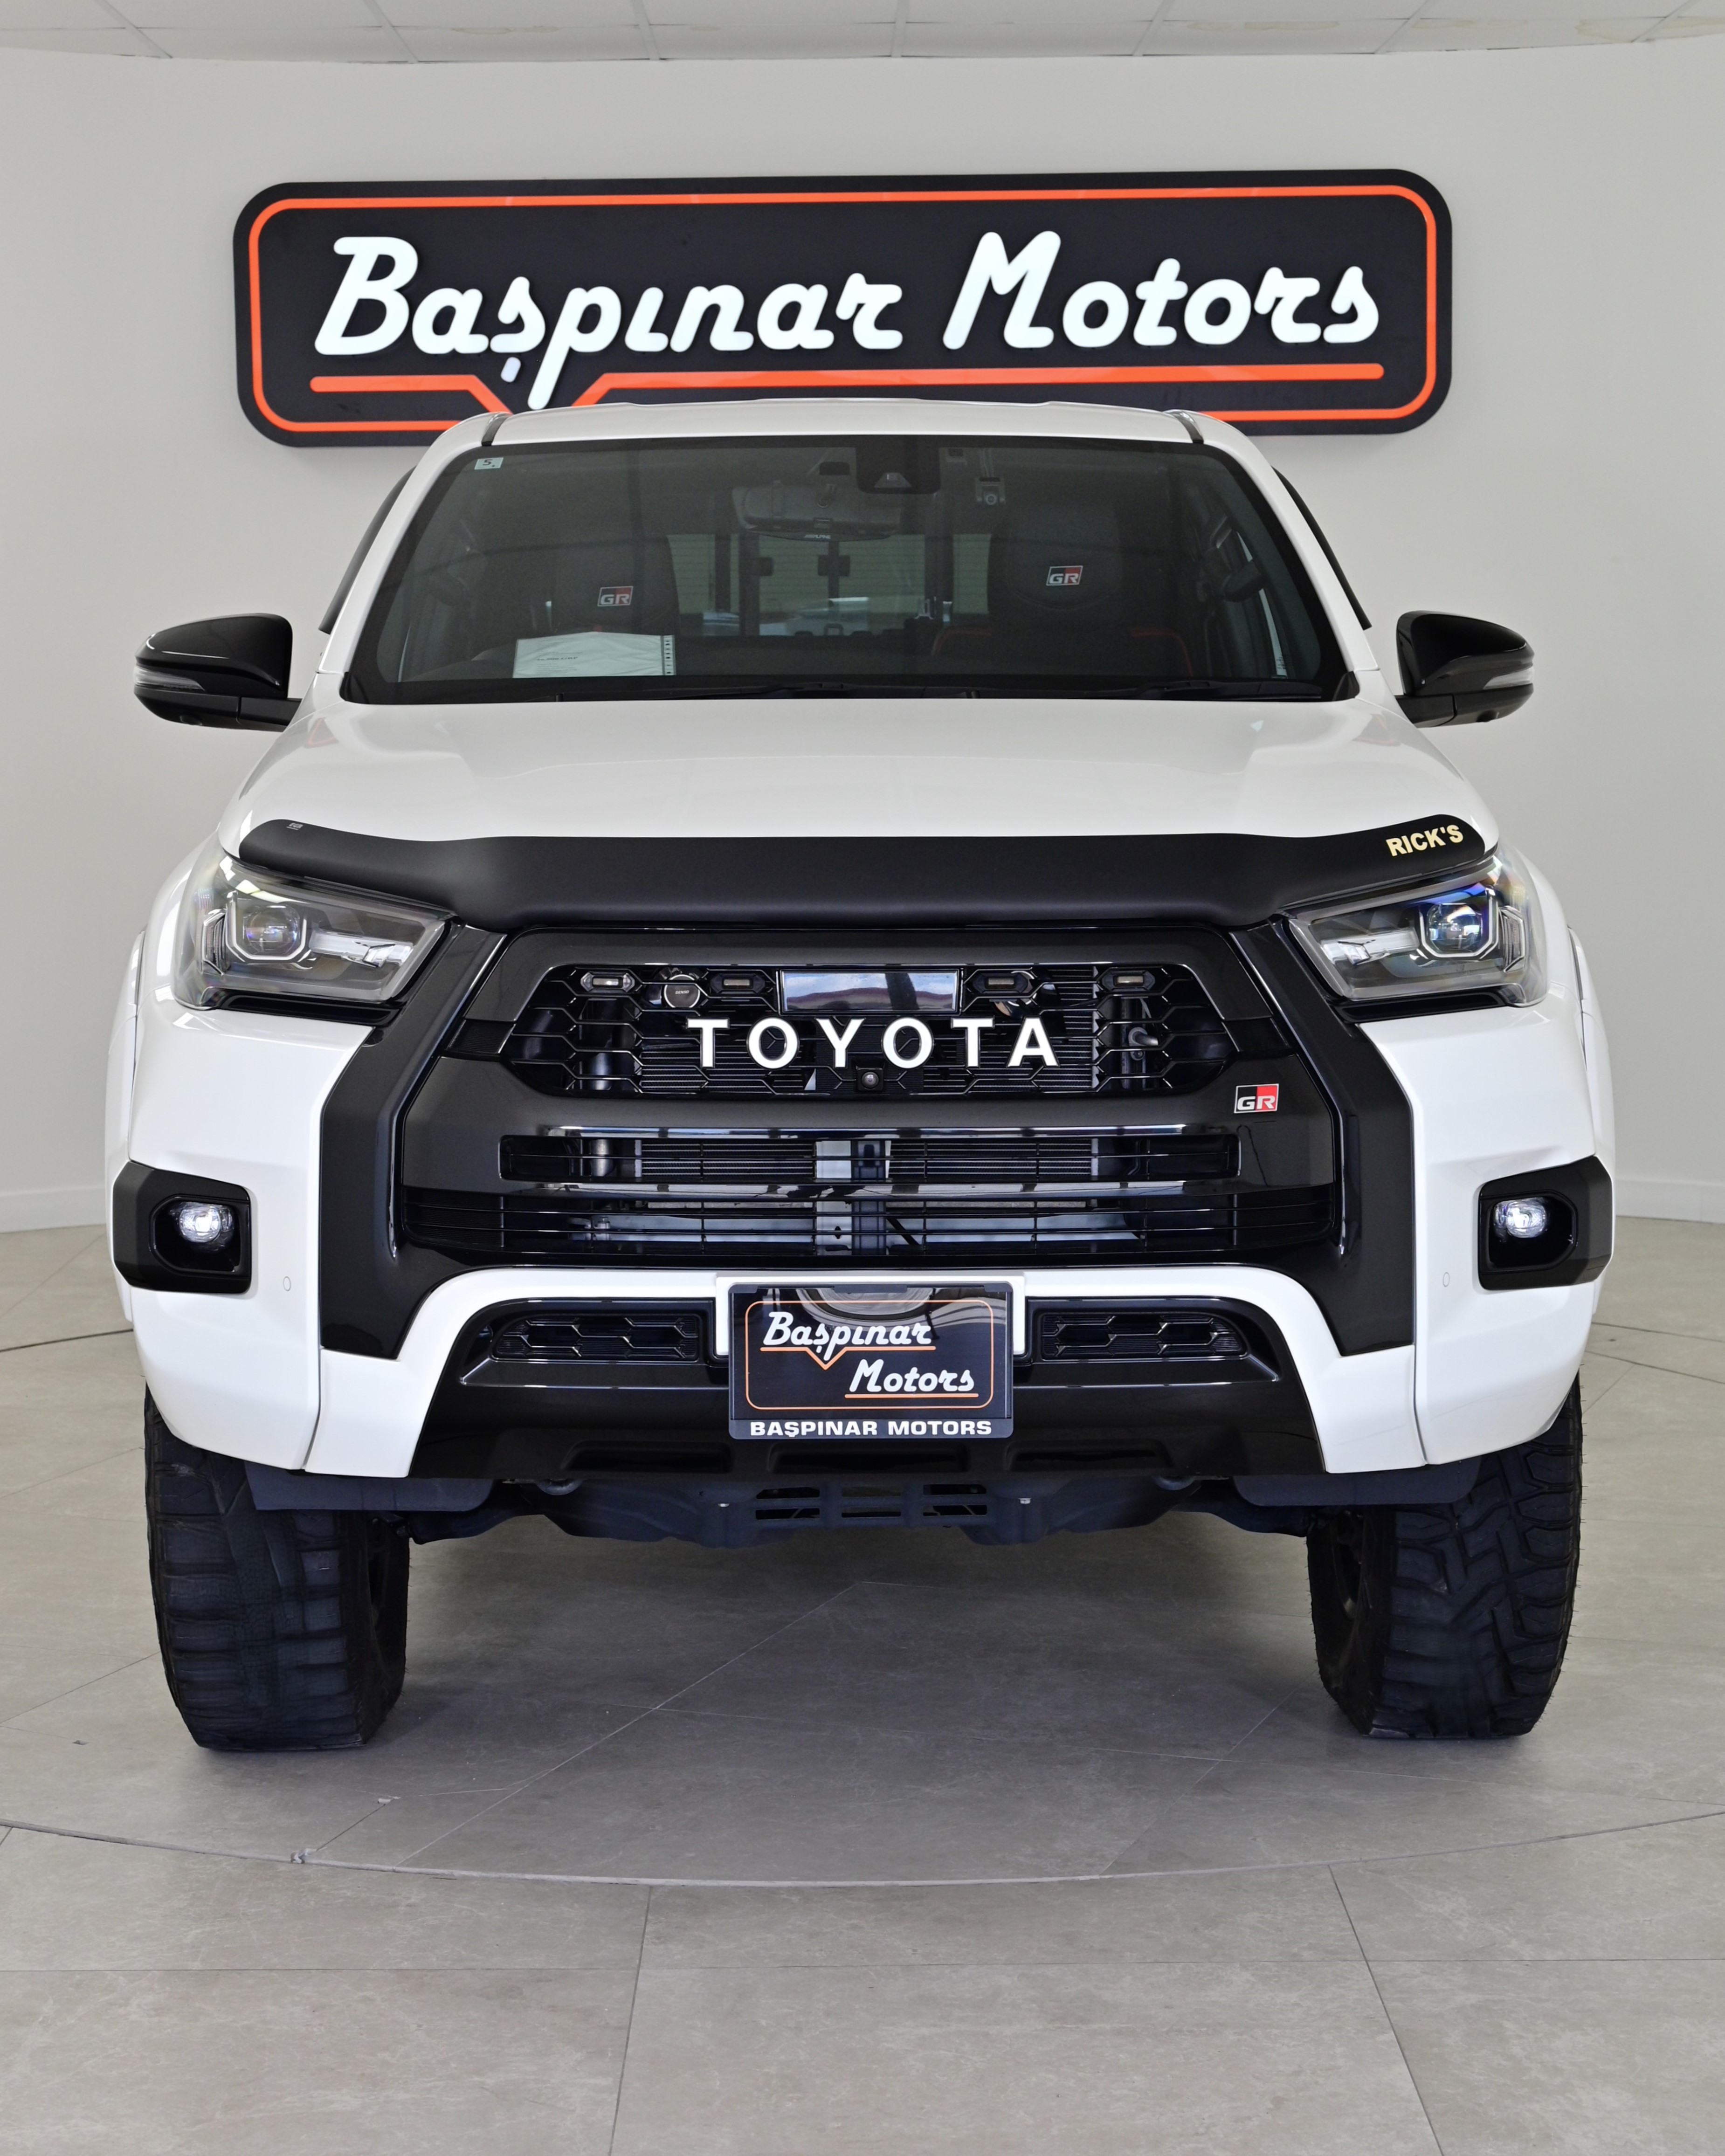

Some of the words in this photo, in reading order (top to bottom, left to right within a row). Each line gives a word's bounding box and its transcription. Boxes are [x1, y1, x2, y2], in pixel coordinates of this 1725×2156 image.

[943, 230, 1379, 350] Motors
[1049, 573, 1079, 584] GR
[600, 594, 629, 605] GR
[1386, 824, 1464, 857] RICK'S
[686, 1017, 1060, 1069] TOYOTA
[1237, 1095, 1276, 1110] GR
[849, 1358, 975, 1392] Motors
[750, 1421, 878, 1438] BAŞPINAR
[887, 1420, 992, 1436] MOTORS
